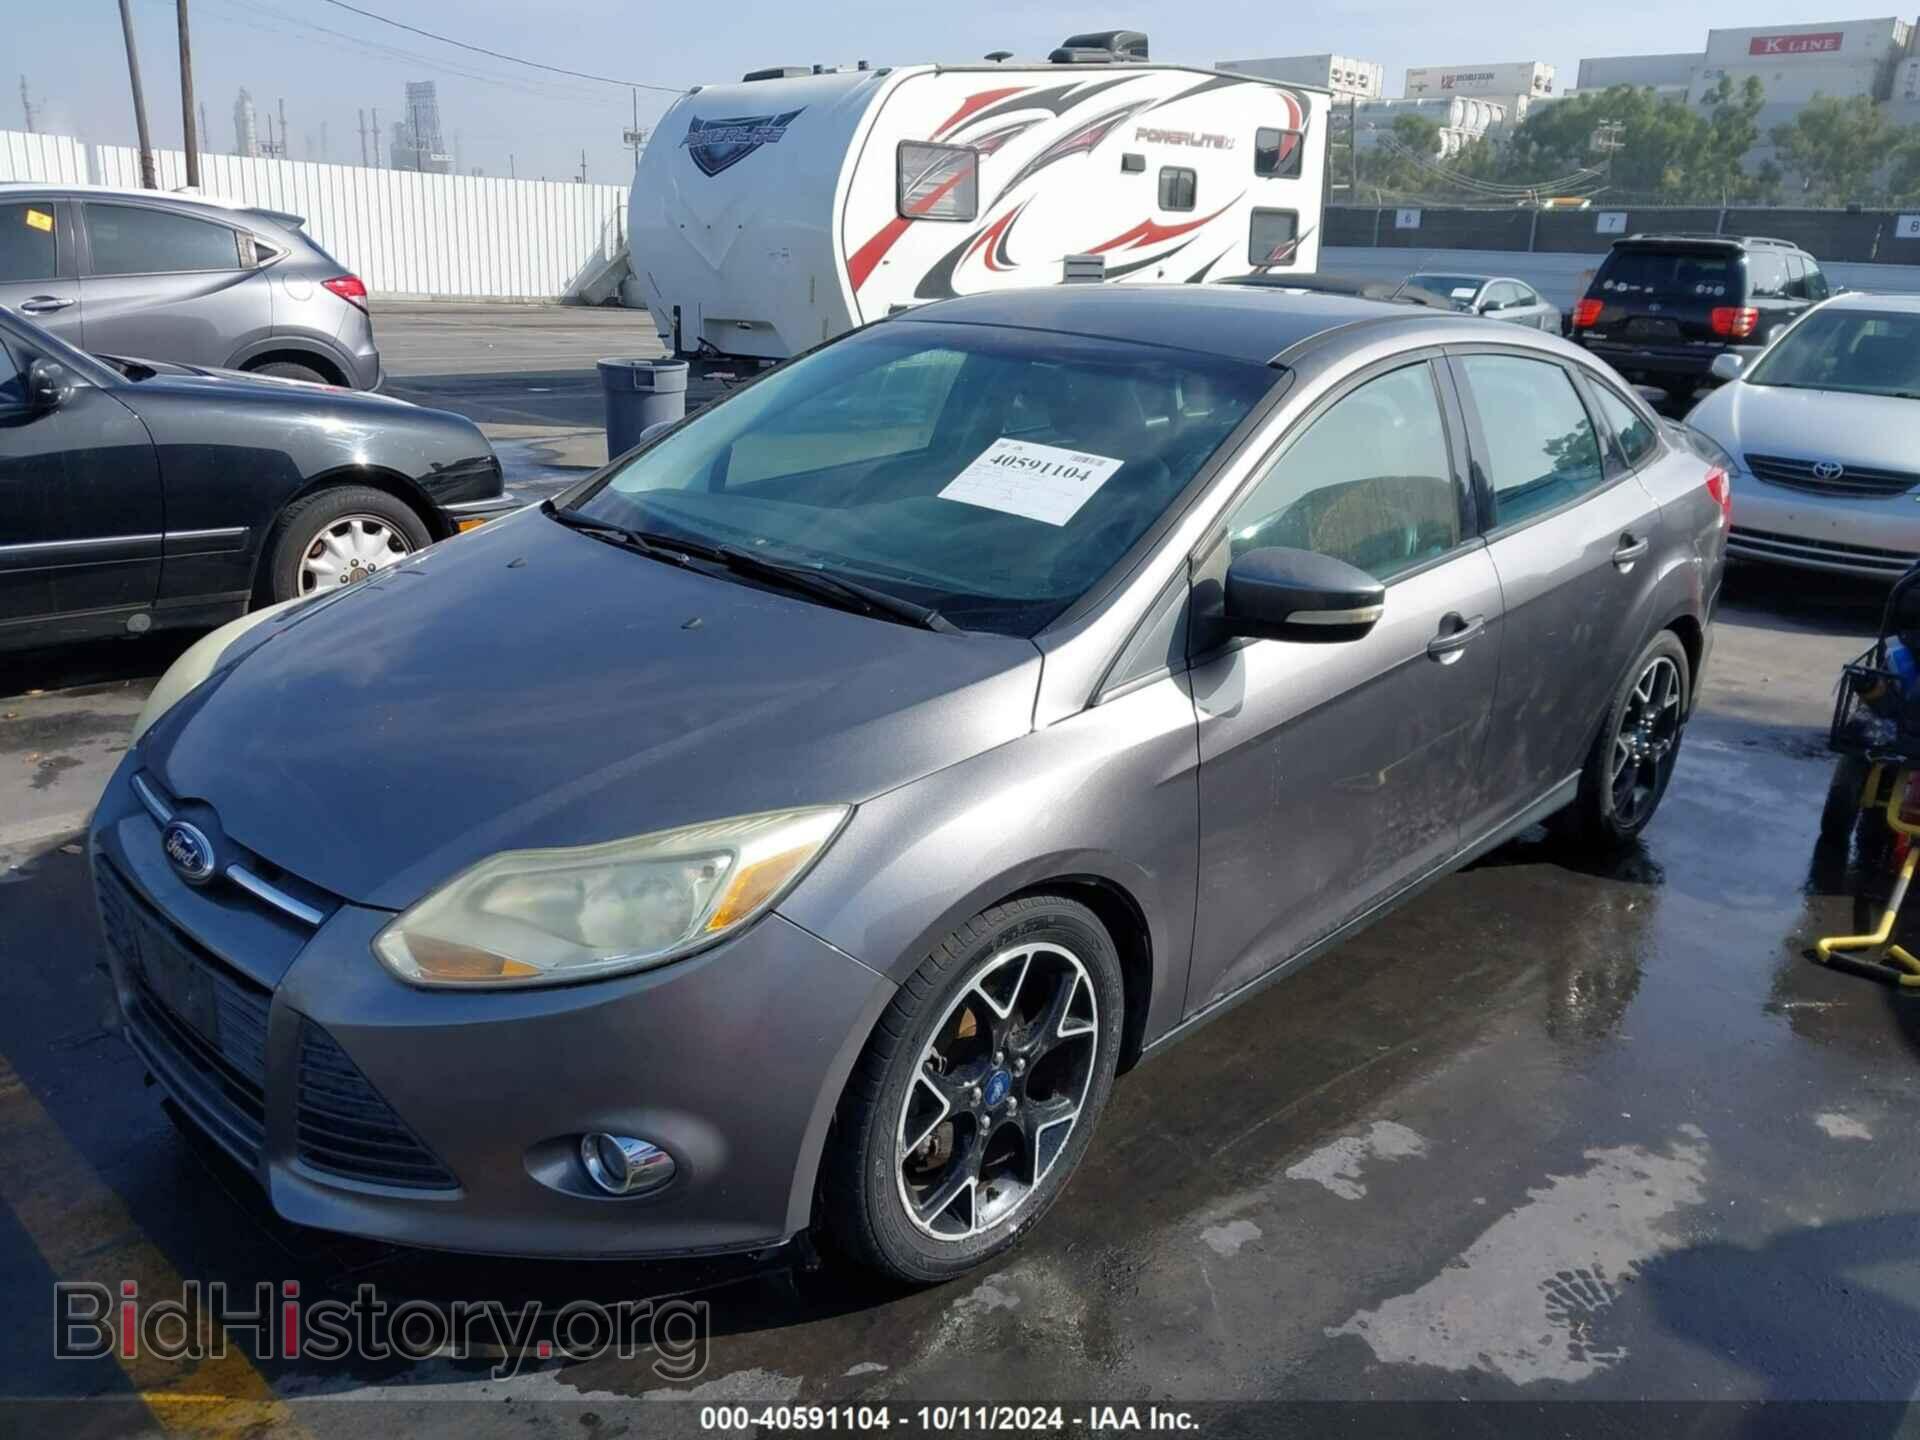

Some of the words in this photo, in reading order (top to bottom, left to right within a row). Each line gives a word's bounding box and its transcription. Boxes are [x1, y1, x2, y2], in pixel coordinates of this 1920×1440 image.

[1764, 37, 1785, 52] K
[1789, 39, 1835, 52] LINE
[1609, 216, 1617, 227] 7
[1910, 220, 1920, 232] 8
[990, 454, 1092, 481] 40591104
[167, 830, 198, 866] Ford
